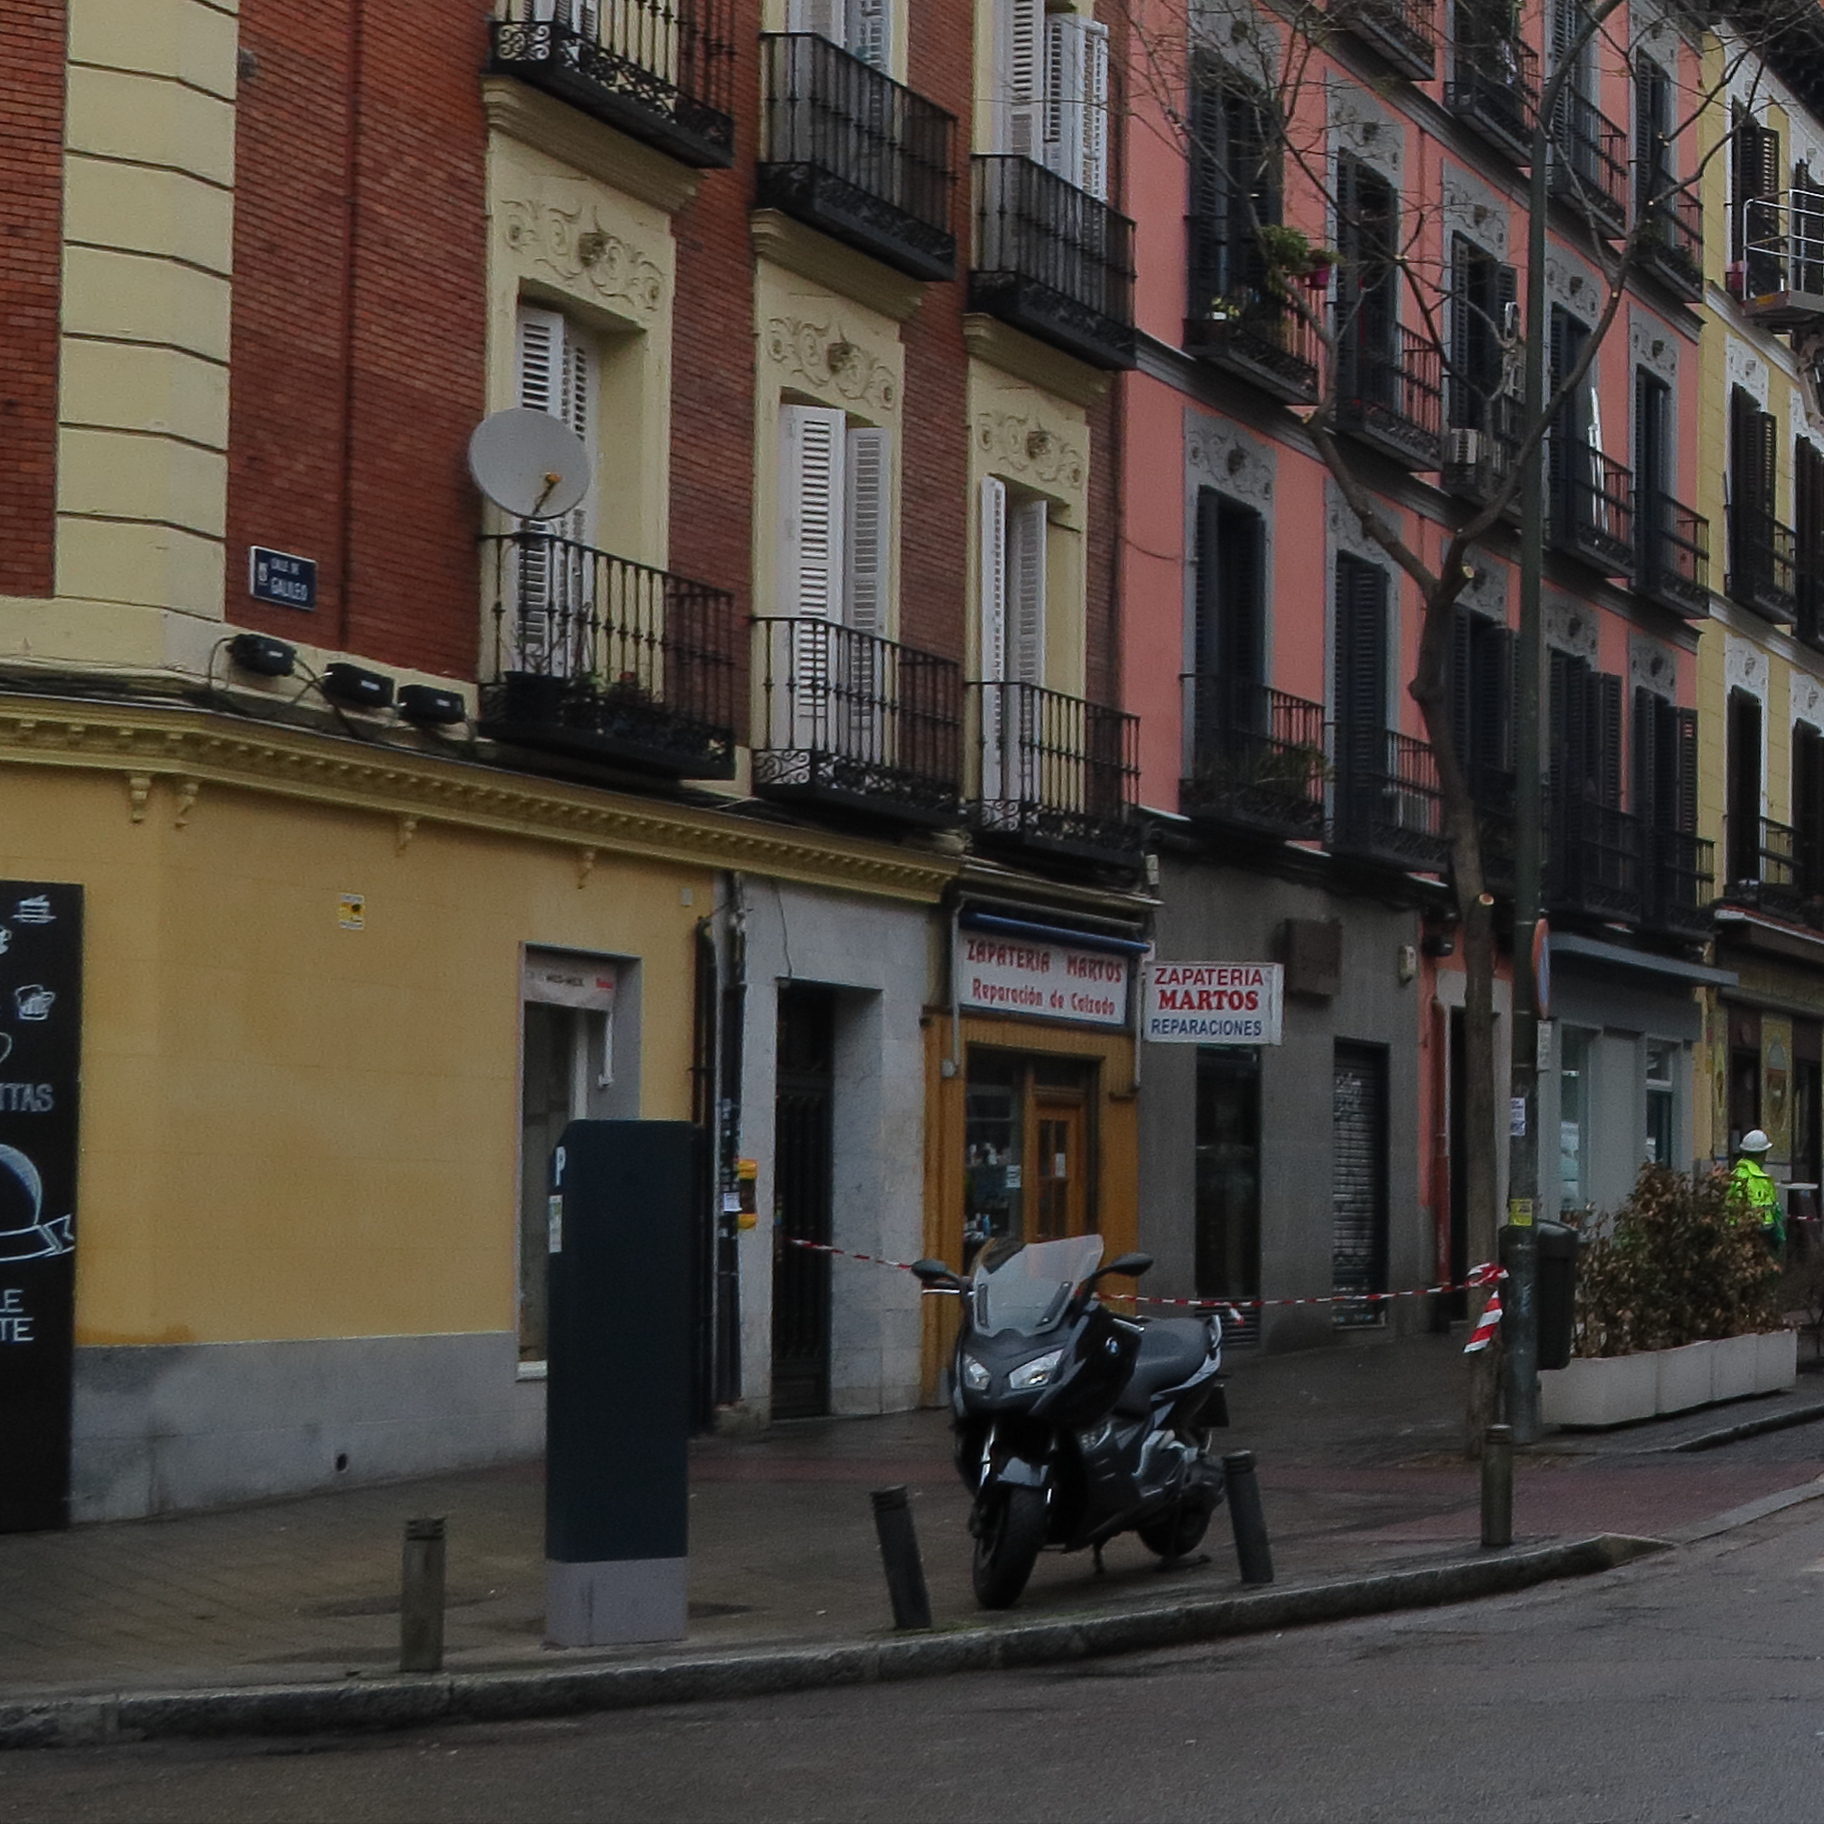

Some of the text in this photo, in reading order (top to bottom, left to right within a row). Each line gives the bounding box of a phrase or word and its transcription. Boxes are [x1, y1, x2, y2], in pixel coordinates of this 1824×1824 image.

[271, 576, 308, 601] GALILEO
[967, 939, 1122, 983] ZAPATERIA MARTOS
[1155, 967, 1264, 986] ZAPATERIA
[972, 977, 1115, 1016] Reparación de Calzado
[1158, 990, 1259, 1011] MARTOS
[1150, 1018, 1262, 1037] REPARACIONES
[555, 1145, 567, 1187] P
